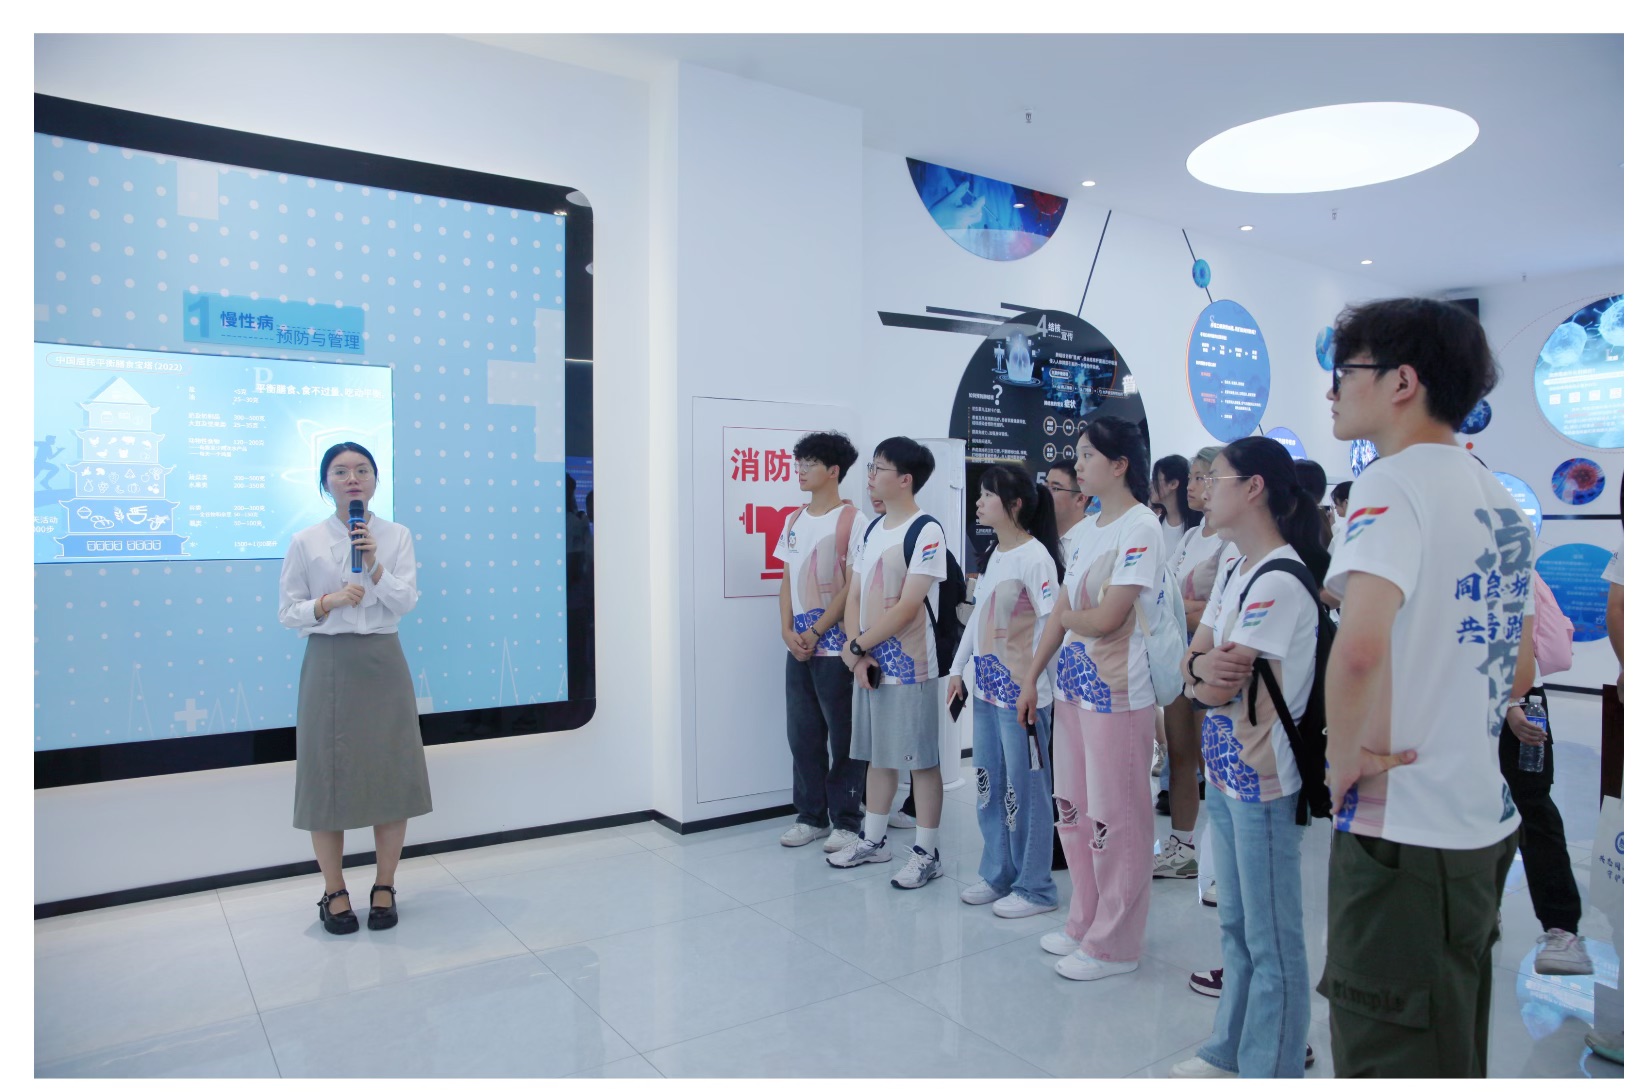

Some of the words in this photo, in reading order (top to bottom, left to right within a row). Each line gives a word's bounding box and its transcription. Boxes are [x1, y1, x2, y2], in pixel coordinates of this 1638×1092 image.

[220, 310, 274, 331] 慢性病
[1036, 314, 1049, 338] 4
[276, 329, 361, 350] 预防与管理
[730, 447, 800, 482] 消防
